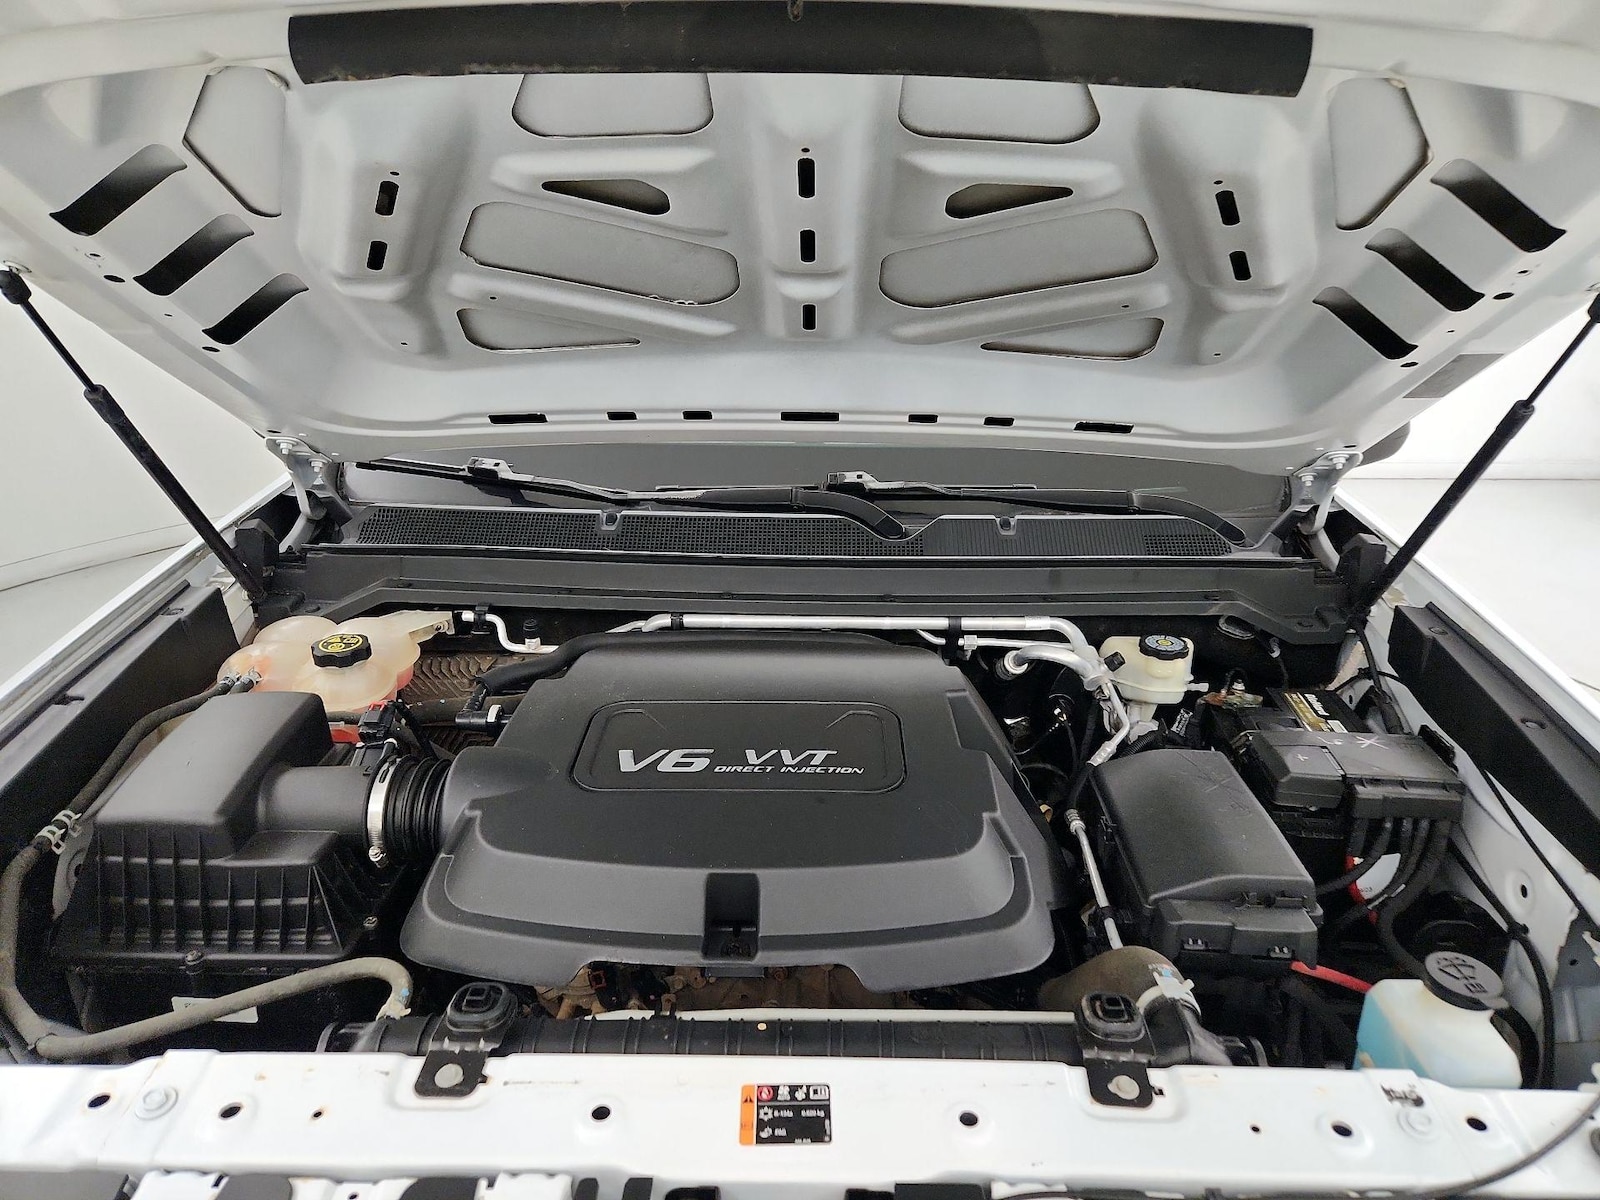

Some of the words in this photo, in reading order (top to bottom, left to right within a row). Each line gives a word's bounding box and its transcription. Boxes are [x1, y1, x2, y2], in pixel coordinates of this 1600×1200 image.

[618, 748, 715, 772] V6
[745, 749, 838, 765] VVT
[713, 765, 776, 774] DIRECT
[779, 766, 865, 775] INJECTION
